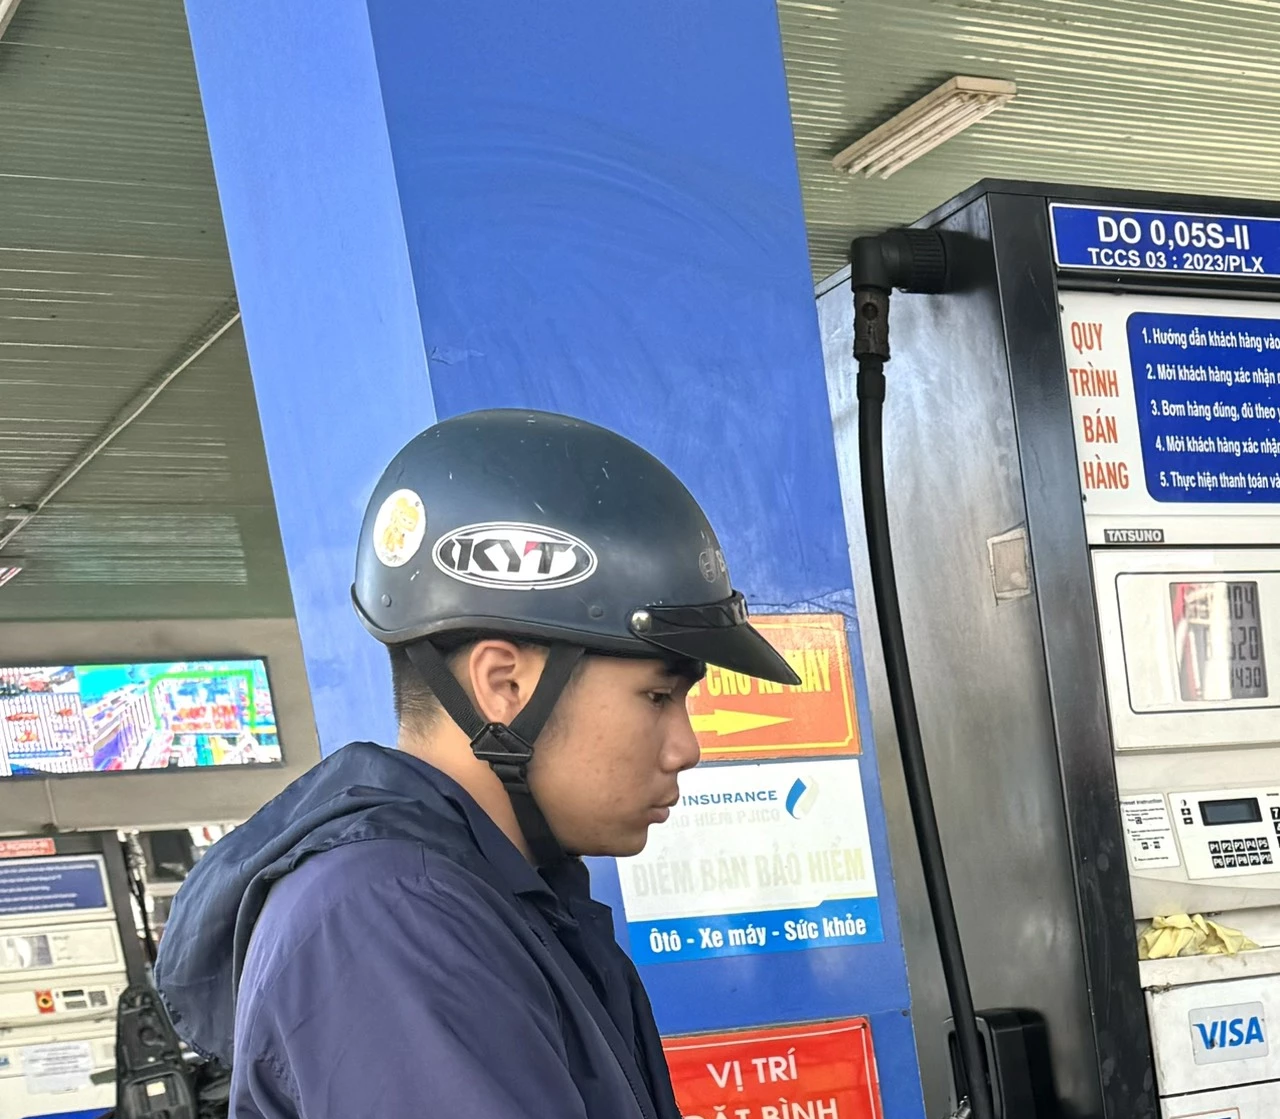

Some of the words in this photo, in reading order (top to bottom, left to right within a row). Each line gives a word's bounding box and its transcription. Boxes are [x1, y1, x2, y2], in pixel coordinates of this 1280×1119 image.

[1097, 216, 1142, 244] DO
[1150, 219, 1250, 250] 0,05S-II
[1087, 247, 1141, 267] TCCS
[1145, 250, 1167, 268] 03
[1172, 255, 1178, 269] :
[1183, 252, 1265, 273] 2023/PLX
[1070, 321, 1103, 354] QUY
[1142, 329, 1151, 344] 1.
[1153, 328, 1186, 349] Hướng
[1189, 327, 1207, 347] dẫn
[1208, 331, 1237, 348] khách
[1239, 332, 1262, 352] hàng
[1264, 334, 1280, 350] vào
[1069, 361, 1120, 398] TRÌNH
[1146, 364, 1156, 380] 2.
[1157, 364, 1176, 380] Mời
[1178, 366, 1207, 382] khách
[1208, 367, 1233, 386] hàng
[1234, 367, 1251, 383] xác
[1253, 368, 1275, 387] nhận
[1082, 407, 1118, 444] BÁN
[1151, 400, 1160, 416] 3.
[1162, 401, 1186, 416] Bơm
[1187, 402, 1211, 421] hàng
[1213, 403, 1239, 422] đúng,
[1241, 402, 1254, 419] đủ
[1255, 402, 1275, 419] theo
[1156, 436, 1165, 452] 4.
[1166, 435, 1185, 452] Mời
[1187, 436, 1215, 453] khách
[1216, 437, 1241, 456] hàng
[1242, 438, 1259, 454] xác
[1083, 453, 1130, 490] HÀNG
[1160, 472, 1169, 487] 5.
[1170, 471, 1196, 491] Thực
[1197, 472, 1218, 491] hiện
[1219, 473, 1246, 488] thanh
[1248, 473, 1269, 489] toán
[1106, 529, 1163, 543] TATSUNO
[456, 537, 573, 575] KYT
[682, 790, 778, 807] INSURANCE
[649, 927, 682, 953] Ôtô
[698, 927, 724, 949] Xe
[728, 922, 767, 948] máy
[784, 916, 819, 941] Sức
[822, 912, 866, 938] khỏe
[1193, 1015, 1265, 1051] VISA
[706, 1060, 744, 1092] VỊ
[751, 1047, 798, 1084] TRÍ
